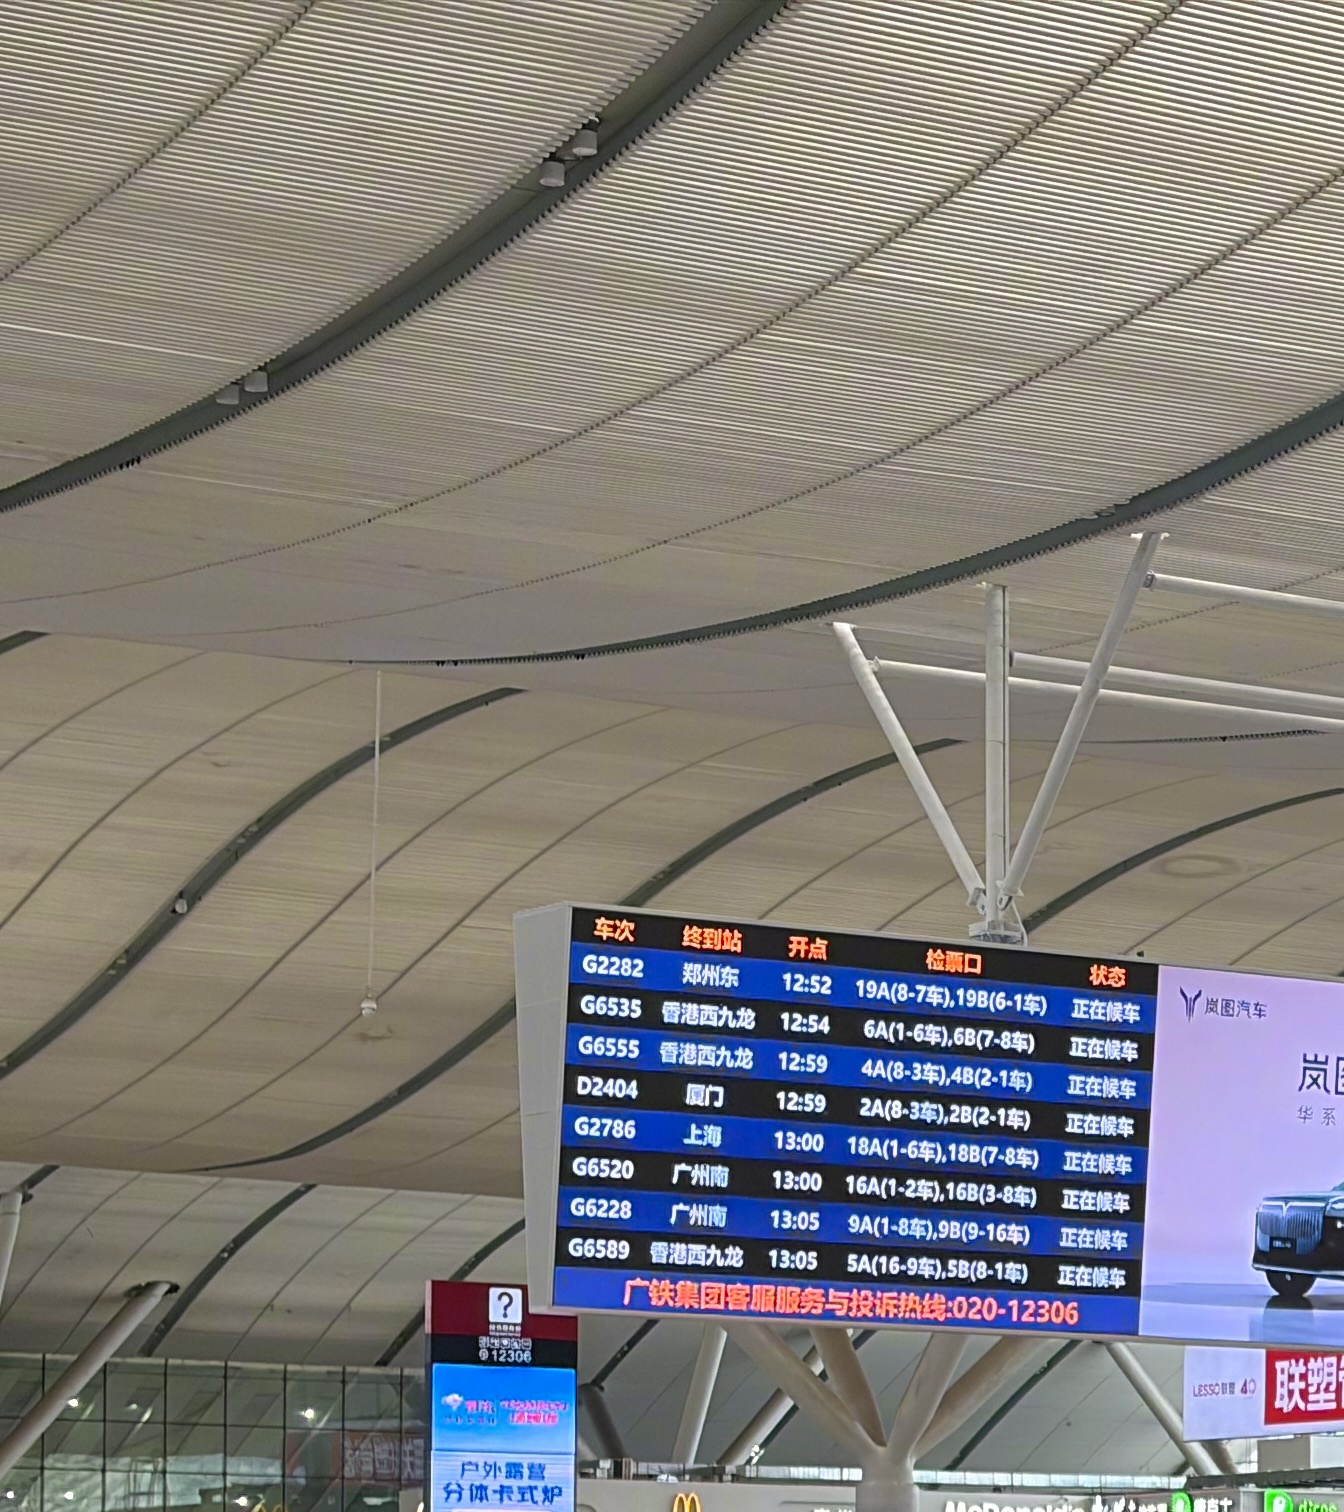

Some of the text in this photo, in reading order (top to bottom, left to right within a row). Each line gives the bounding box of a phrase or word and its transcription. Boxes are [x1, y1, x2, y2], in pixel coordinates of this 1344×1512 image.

[593, 916, 1127, 988] 车次 终到站 开点 检票口 状态
[582, 955, 644, 978] G2282
[682, 962, 740, 988] 郑州东
[782, 973, 832, 995] 12:52
[1071, 998, 1141, 1025] 正在候车
[1204, 996, 1268, 1020] 岚图汽车
[580, 995, 1139, 1063] G6535 香港西九龙 12:54 6A(1-6车),6B(7-8车) 正在候车
[578, 1036, 1137, 1100] G6555 香港西九龙 12:59 4A(8-3车),4B(2-1车) 正在候车
[574, 1117, 1133, 1176] G2786 上海 13:00 18A(1-6车),18B(7-8车) 正在候车
[568, 1238, 1126, 1289] G6589 香港西九龙 13:05 5A(16-9车),5B(8-1车) 正在候车
[492, 1350, 531, 1363] 12306
